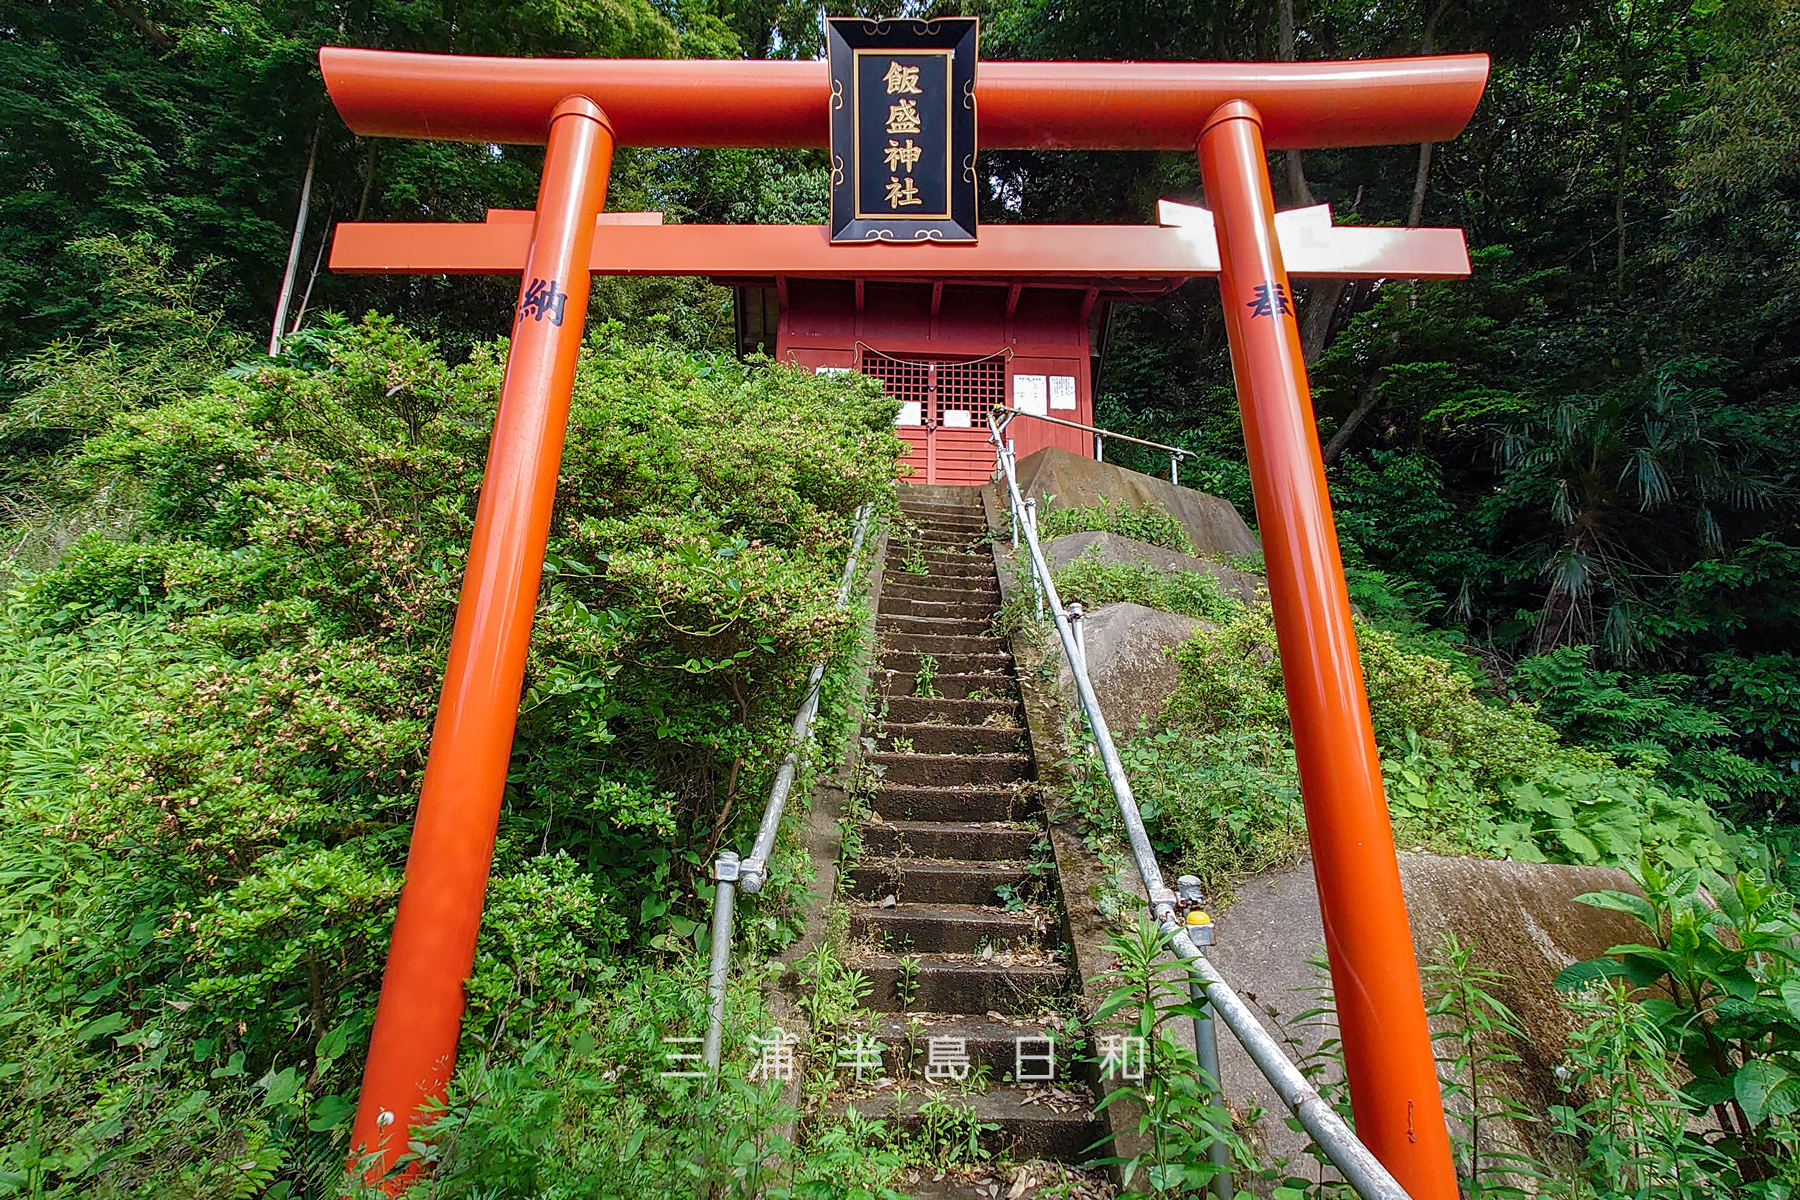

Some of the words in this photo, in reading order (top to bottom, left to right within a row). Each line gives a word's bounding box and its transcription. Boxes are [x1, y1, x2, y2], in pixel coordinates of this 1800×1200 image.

[882, 60, 923, 209] 飯盛神社
[518, 278, 568, 327] 納
[1246, 280, 1293, 325] 奉
